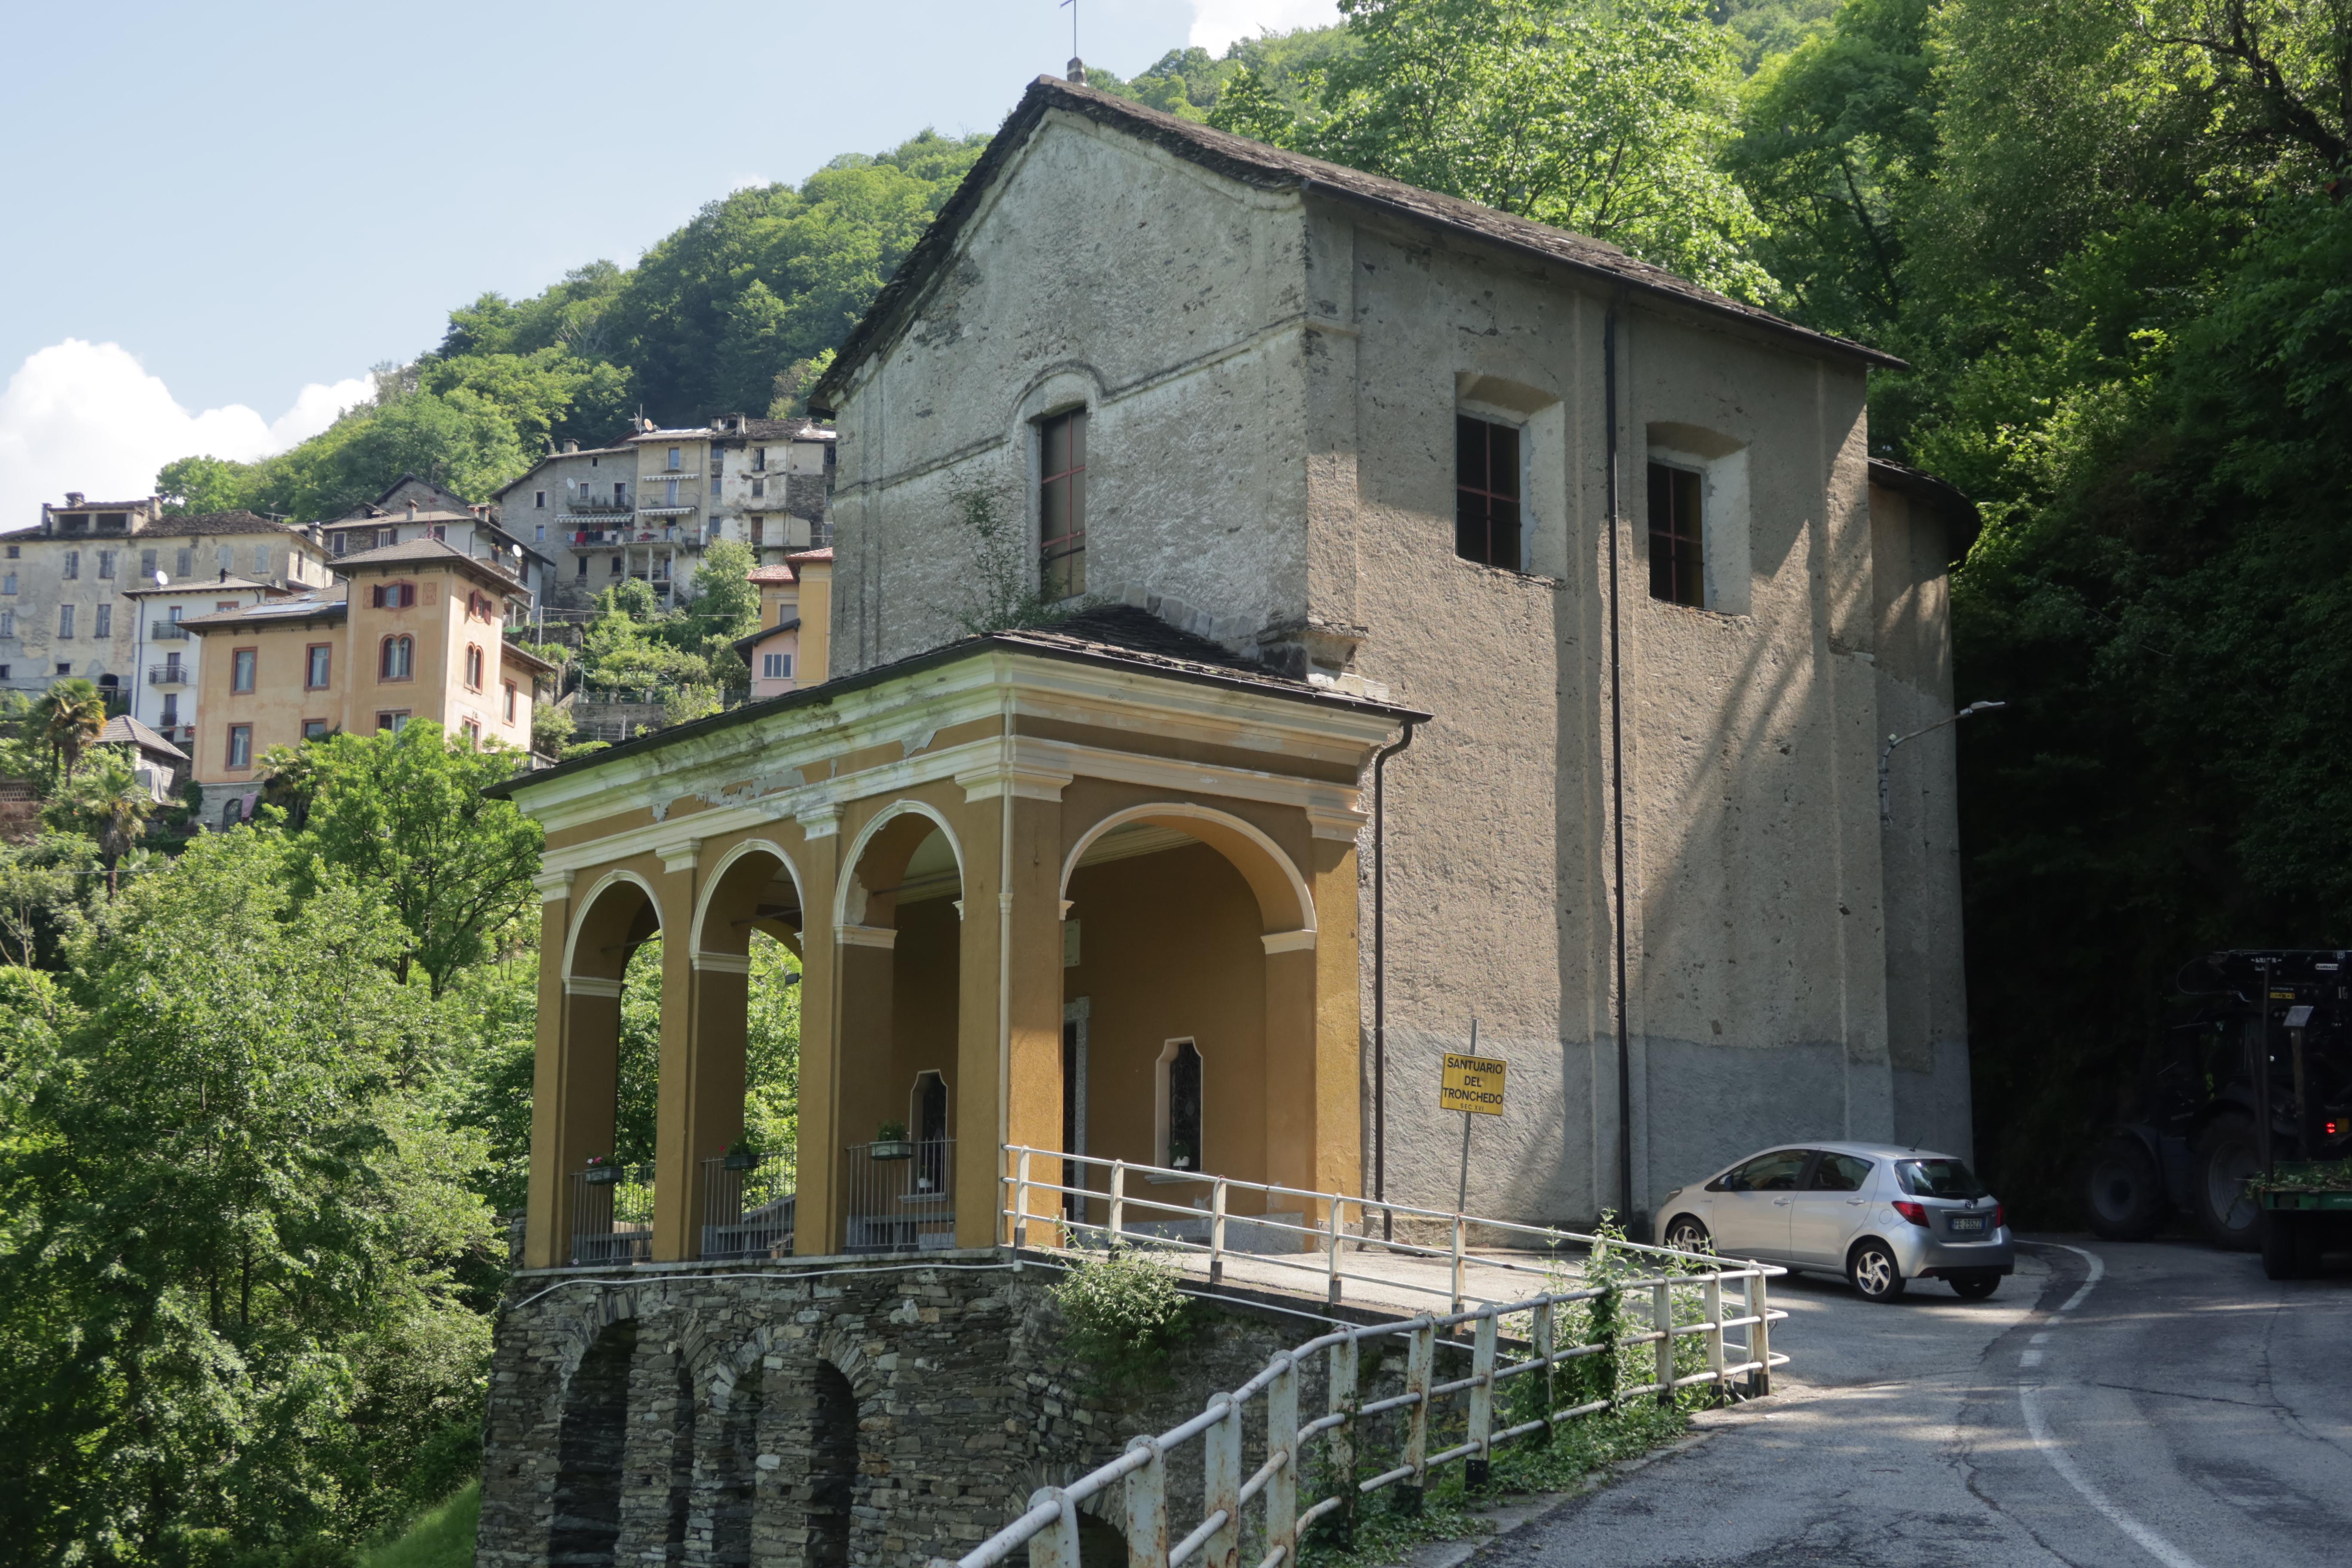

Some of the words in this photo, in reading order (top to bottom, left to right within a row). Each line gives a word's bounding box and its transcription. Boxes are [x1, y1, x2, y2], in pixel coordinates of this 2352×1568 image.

[1447, 1057, 1503, 1074] SANTUARIO
[1464, 1075, 1482, 1087] DEL
[1443, 1087, 1503, 1105] TRONCHEDO
